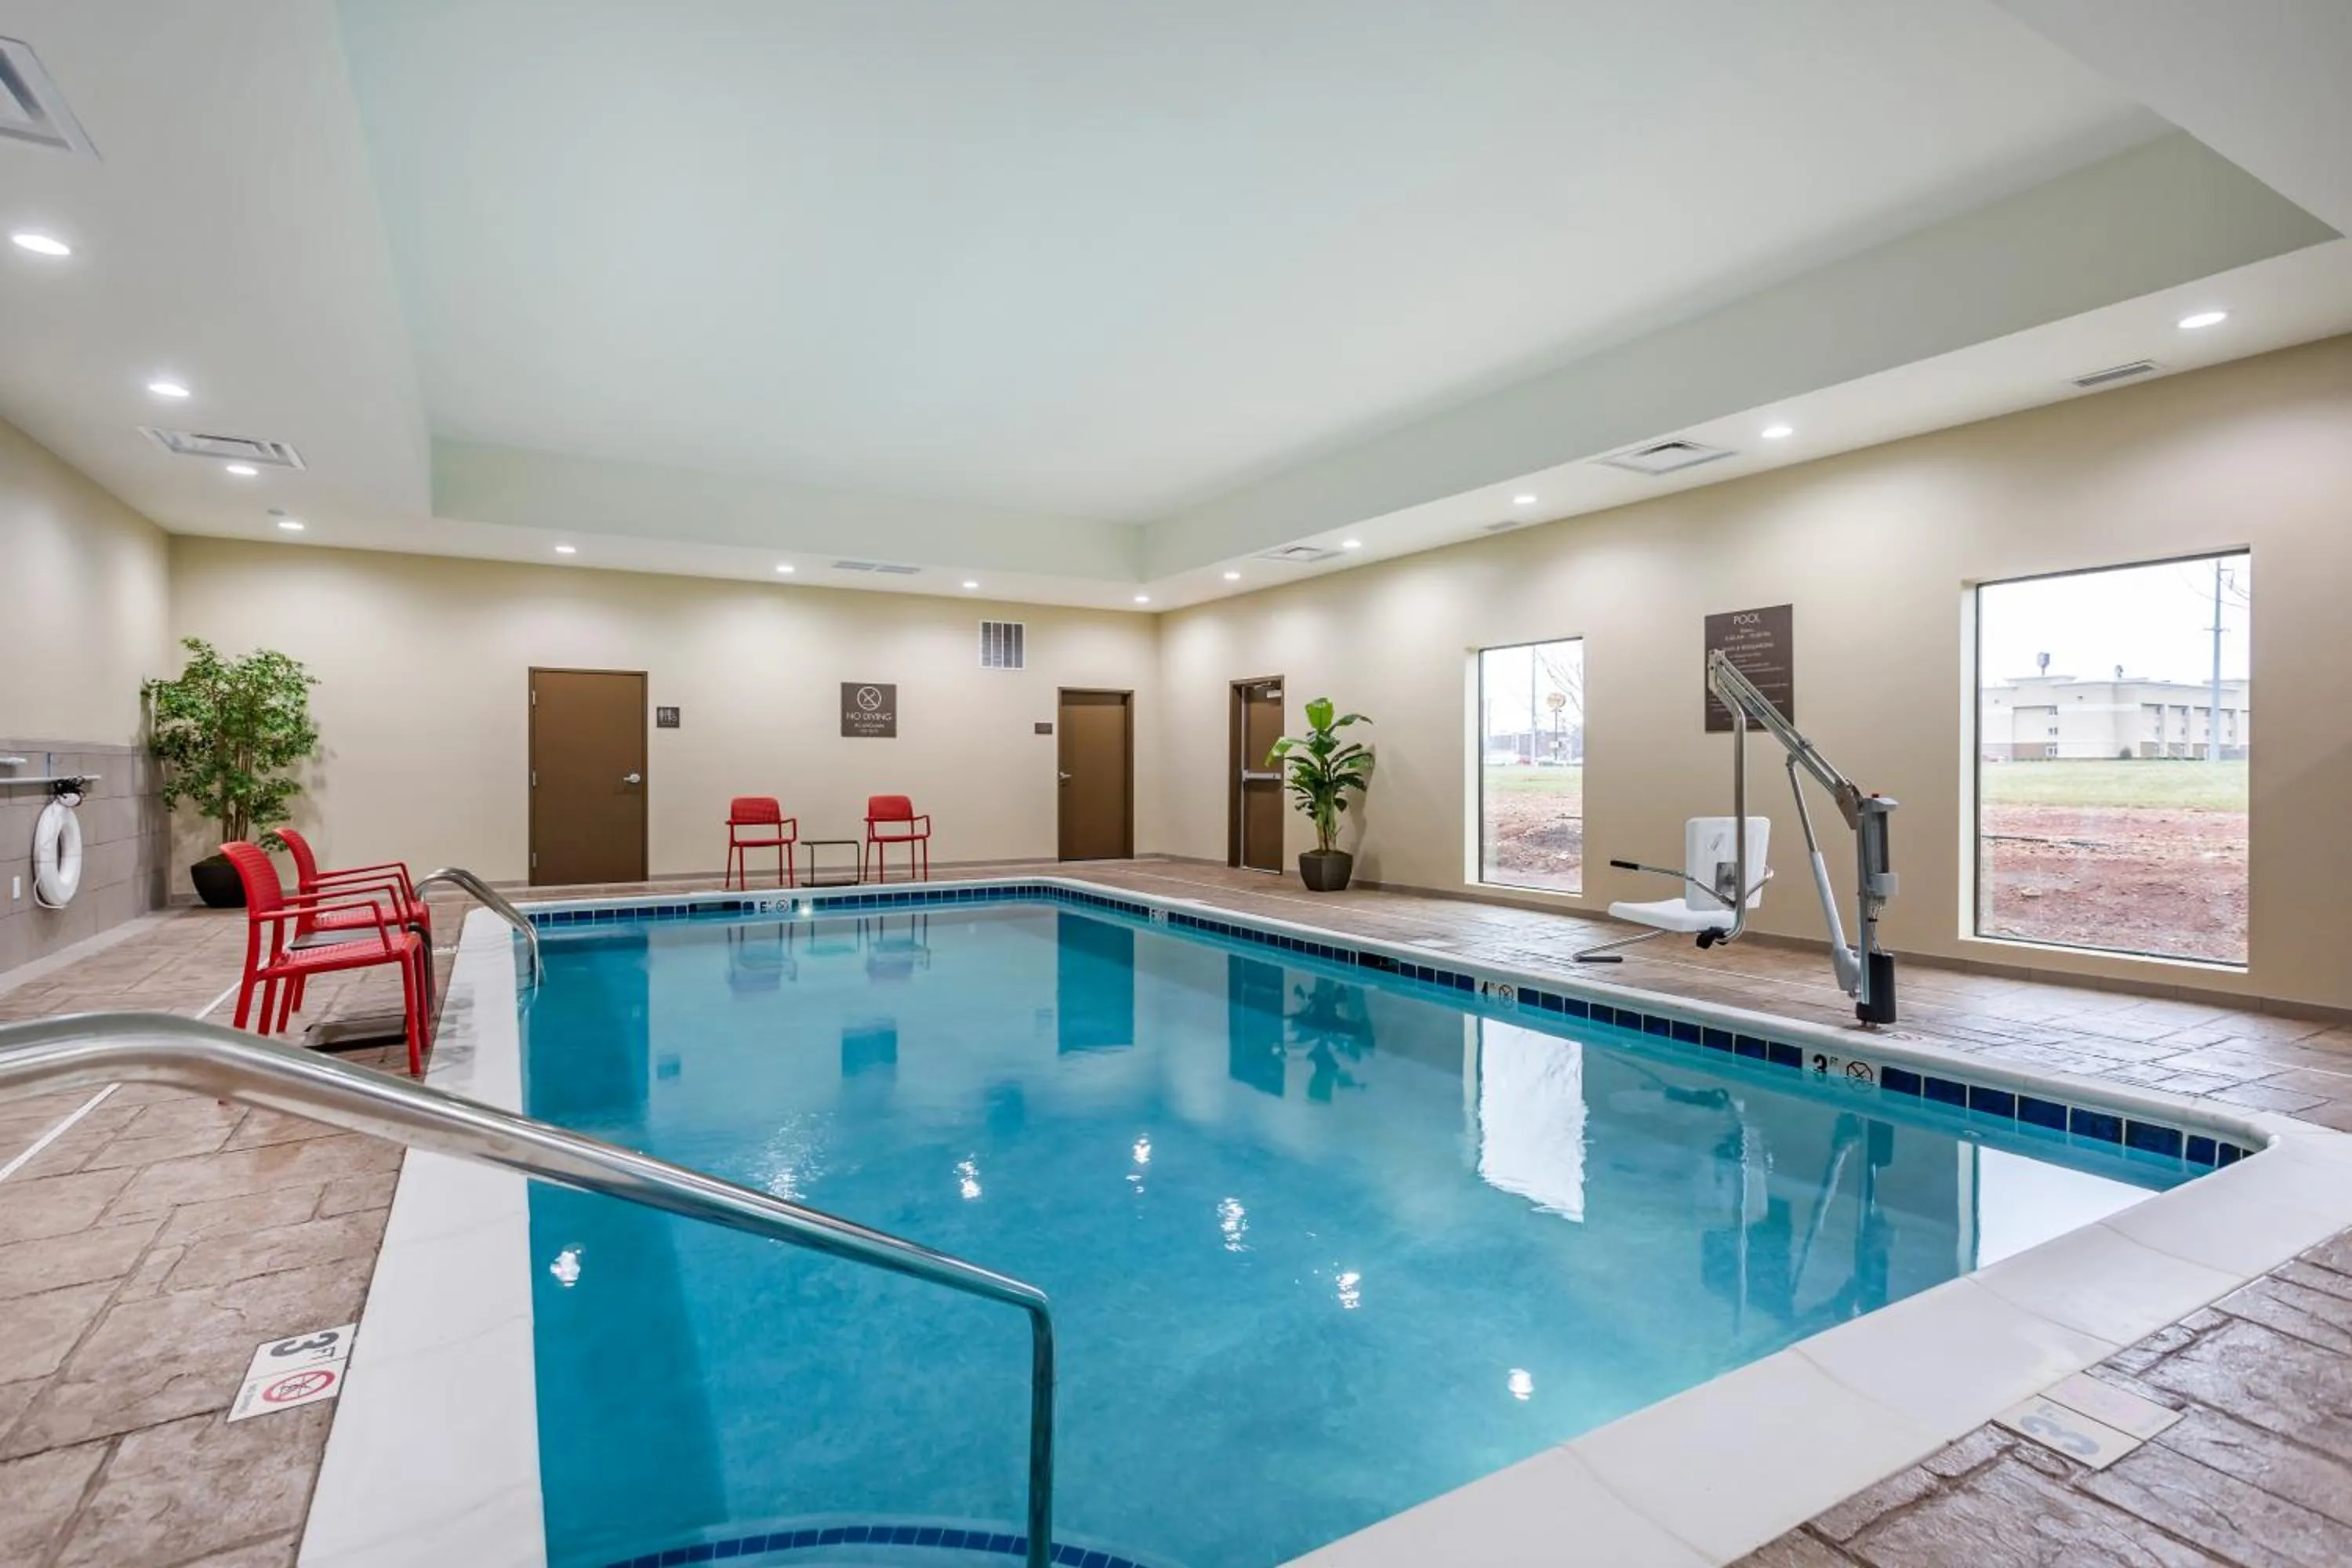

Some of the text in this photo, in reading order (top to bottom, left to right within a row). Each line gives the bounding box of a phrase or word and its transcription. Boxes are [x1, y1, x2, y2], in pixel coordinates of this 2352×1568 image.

[1733, 613, 1761, 625] POOL
[846, 711, 861, 720] NO
[270, 1332, 339, 1357] 3
[2020, 1415, 2100, 1456] 3
